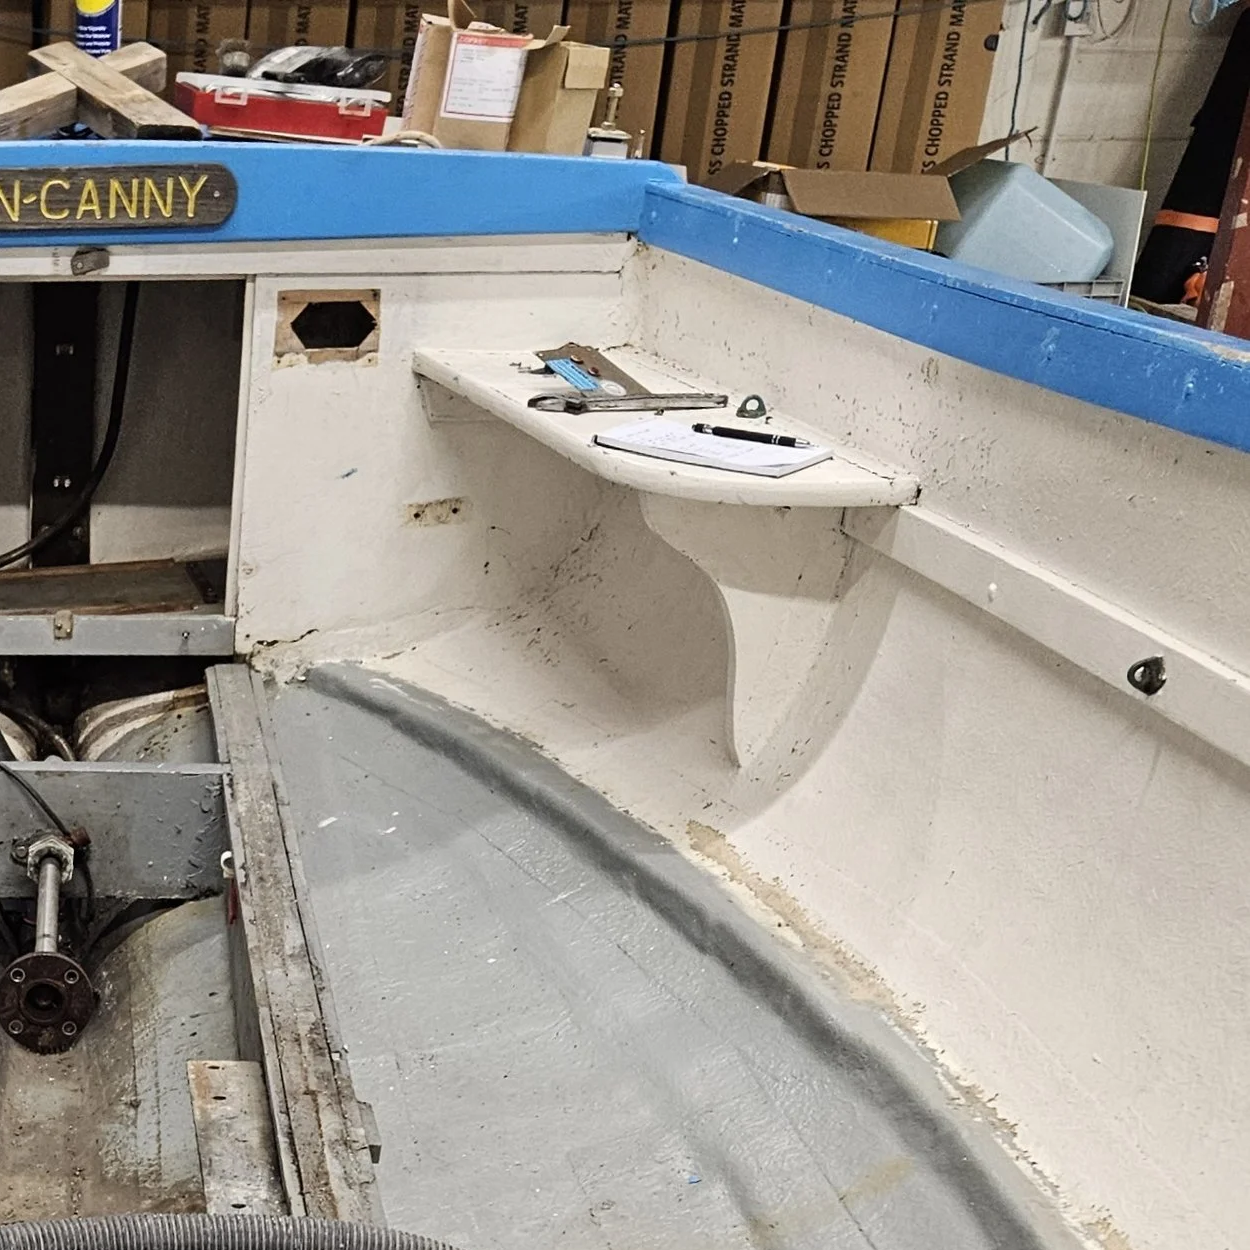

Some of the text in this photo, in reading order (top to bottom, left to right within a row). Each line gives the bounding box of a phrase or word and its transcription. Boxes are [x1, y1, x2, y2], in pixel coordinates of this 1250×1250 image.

[721, 33, 741, 87] STRAND
[818, 92, 842, 157] CHOPPED
[830, 32, 852, 88] STRAND
[924, 91, 949, 156] CHOPPED
[938, 31, 961, 87] STRAND
[711, 91, 733, 156] CHOPPED
